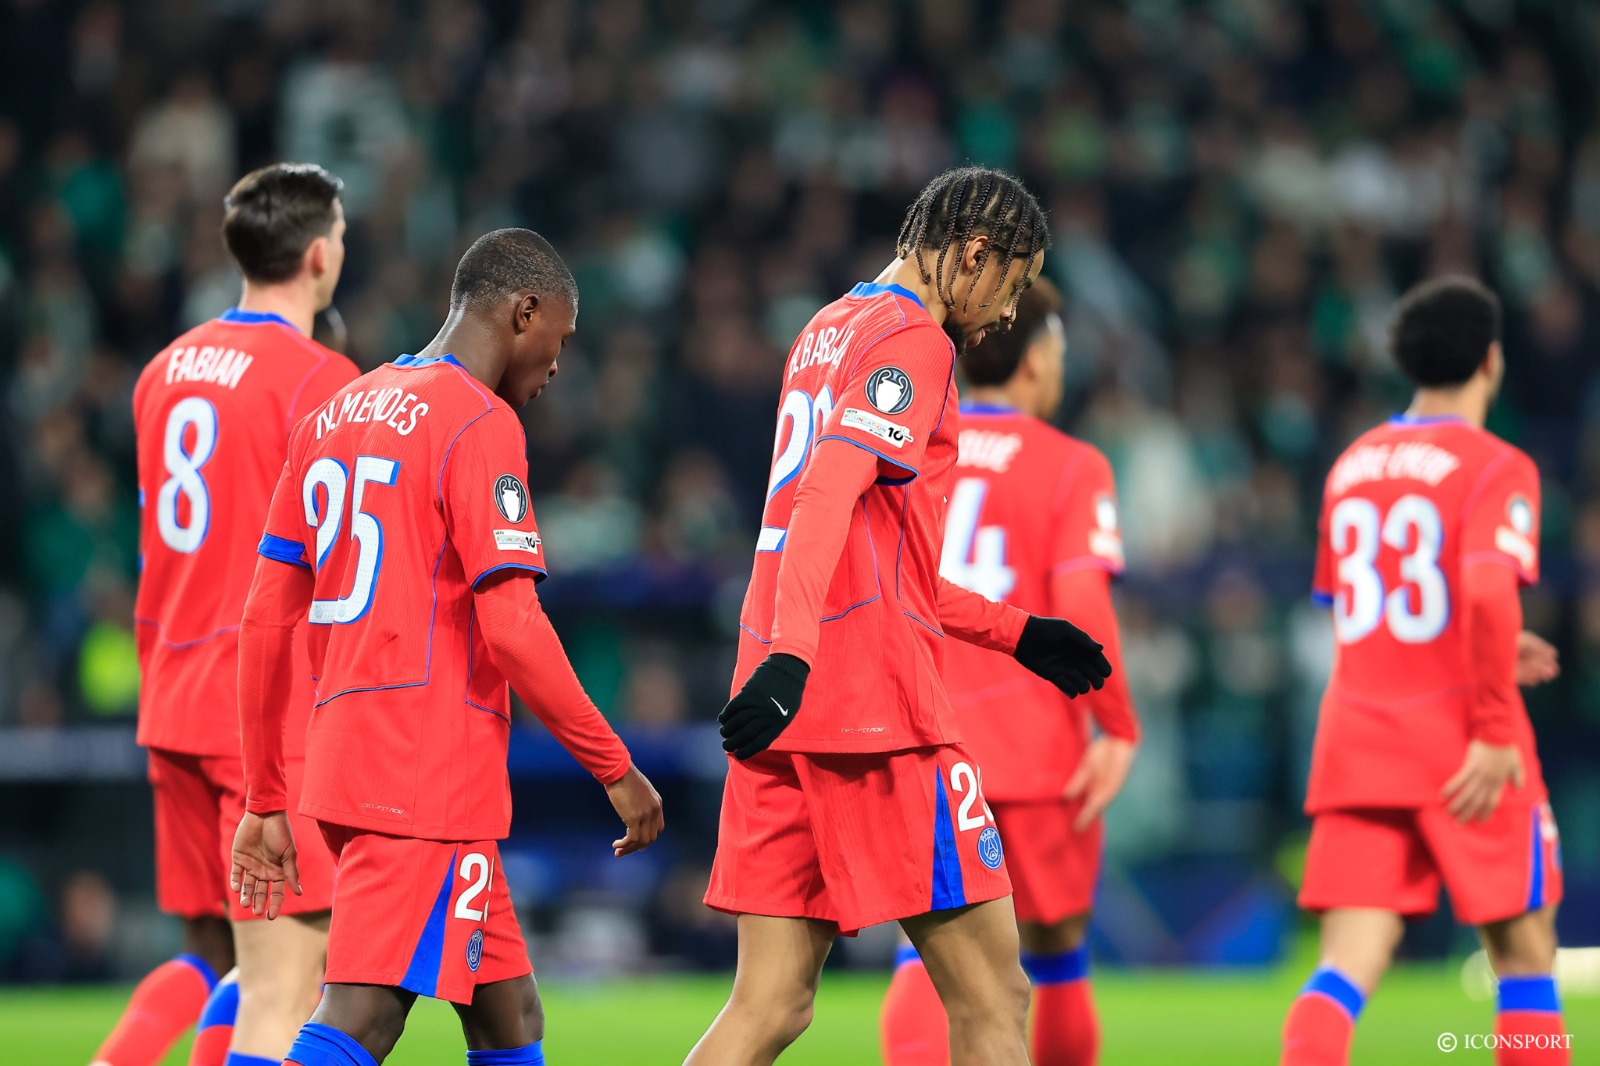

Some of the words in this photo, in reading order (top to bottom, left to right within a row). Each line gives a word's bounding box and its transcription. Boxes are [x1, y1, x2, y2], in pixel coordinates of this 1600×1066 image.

[165, 346, 253, 390] FABIAN
[844, 414, 887, 433] FOUNDATION
[157, 396, 218, 554] 8
[755, 384, 835, 553] 2
[888, 427, 904, 441] 10
[302, 455, 402, 625] 25
[938, 477, 1018, 603] 4
[1329, 494, 1453, 645] 33
[454, 852, 495, 924] 2
